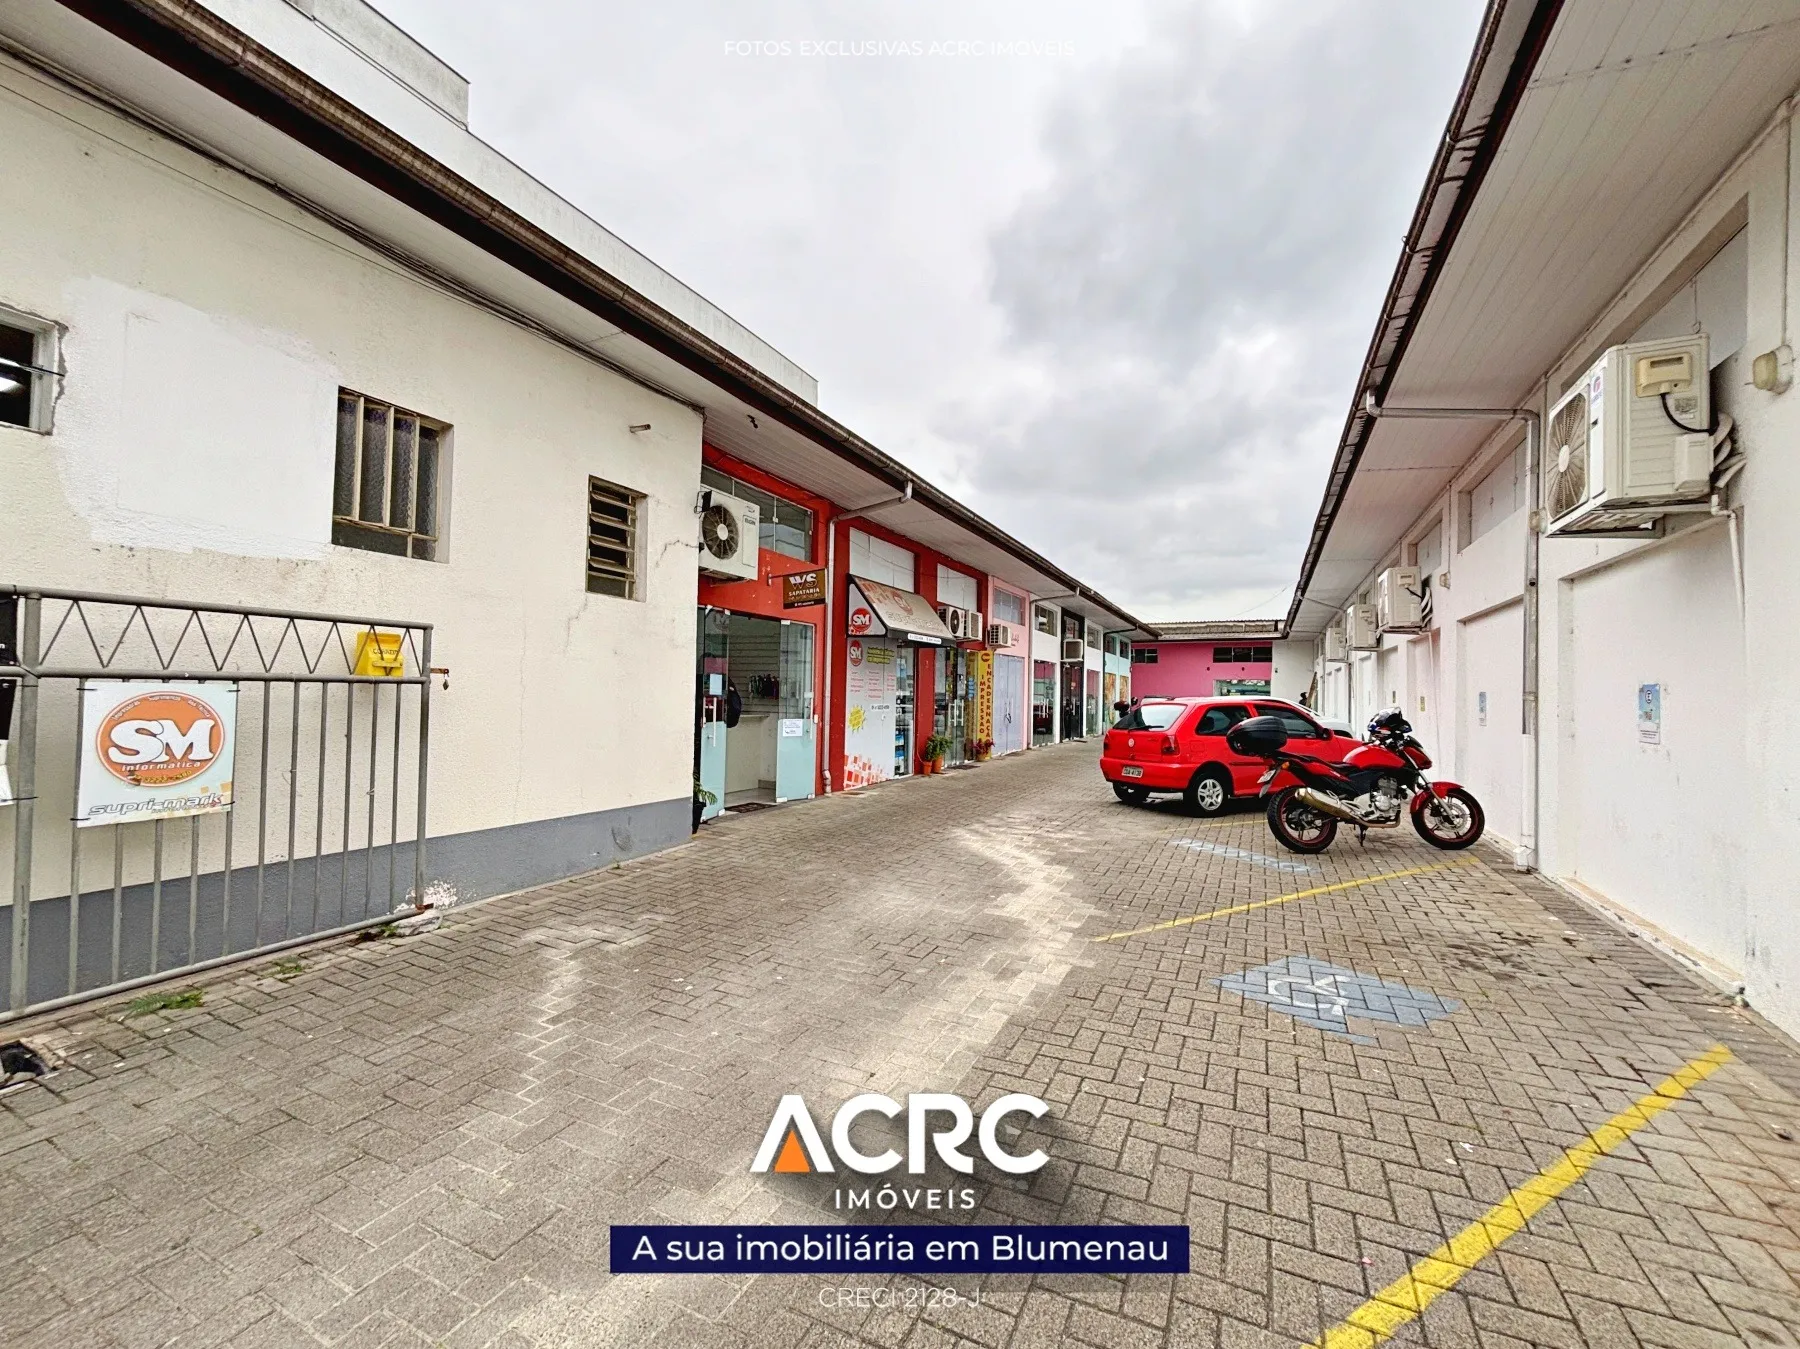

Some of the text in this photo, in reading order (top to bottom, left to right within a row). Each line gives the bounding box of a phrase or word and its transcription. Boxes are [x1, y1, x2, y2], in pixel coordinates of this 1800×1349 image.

[789, 573, 817, 589] WS
[788, 587, 820, 597] SAPATARIA
[852, 614, 870, 625] SM
[850, 646, 862, 659] SM
[108, 719, 215, 764] SM
